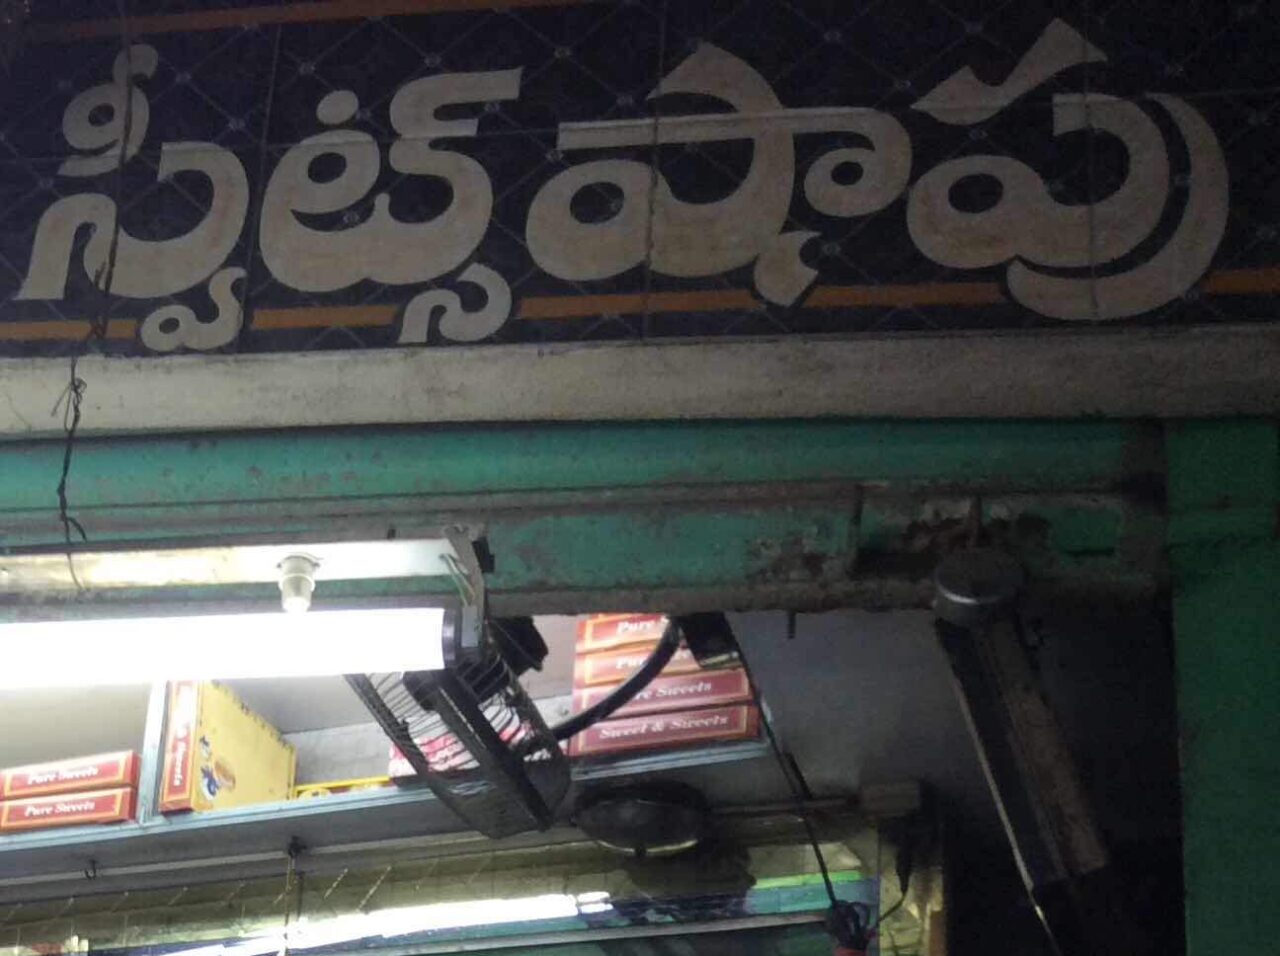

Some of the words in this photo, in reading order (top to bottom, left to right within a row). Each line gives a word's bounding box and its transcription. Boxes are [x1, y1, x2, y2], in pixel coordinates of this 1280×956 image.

[656, 681, 712, 698] Sweets
[599, 723, 647, 740] Sweet
[651, 719, 665, 732] &
[670, 714, 728, 730] Sweets
